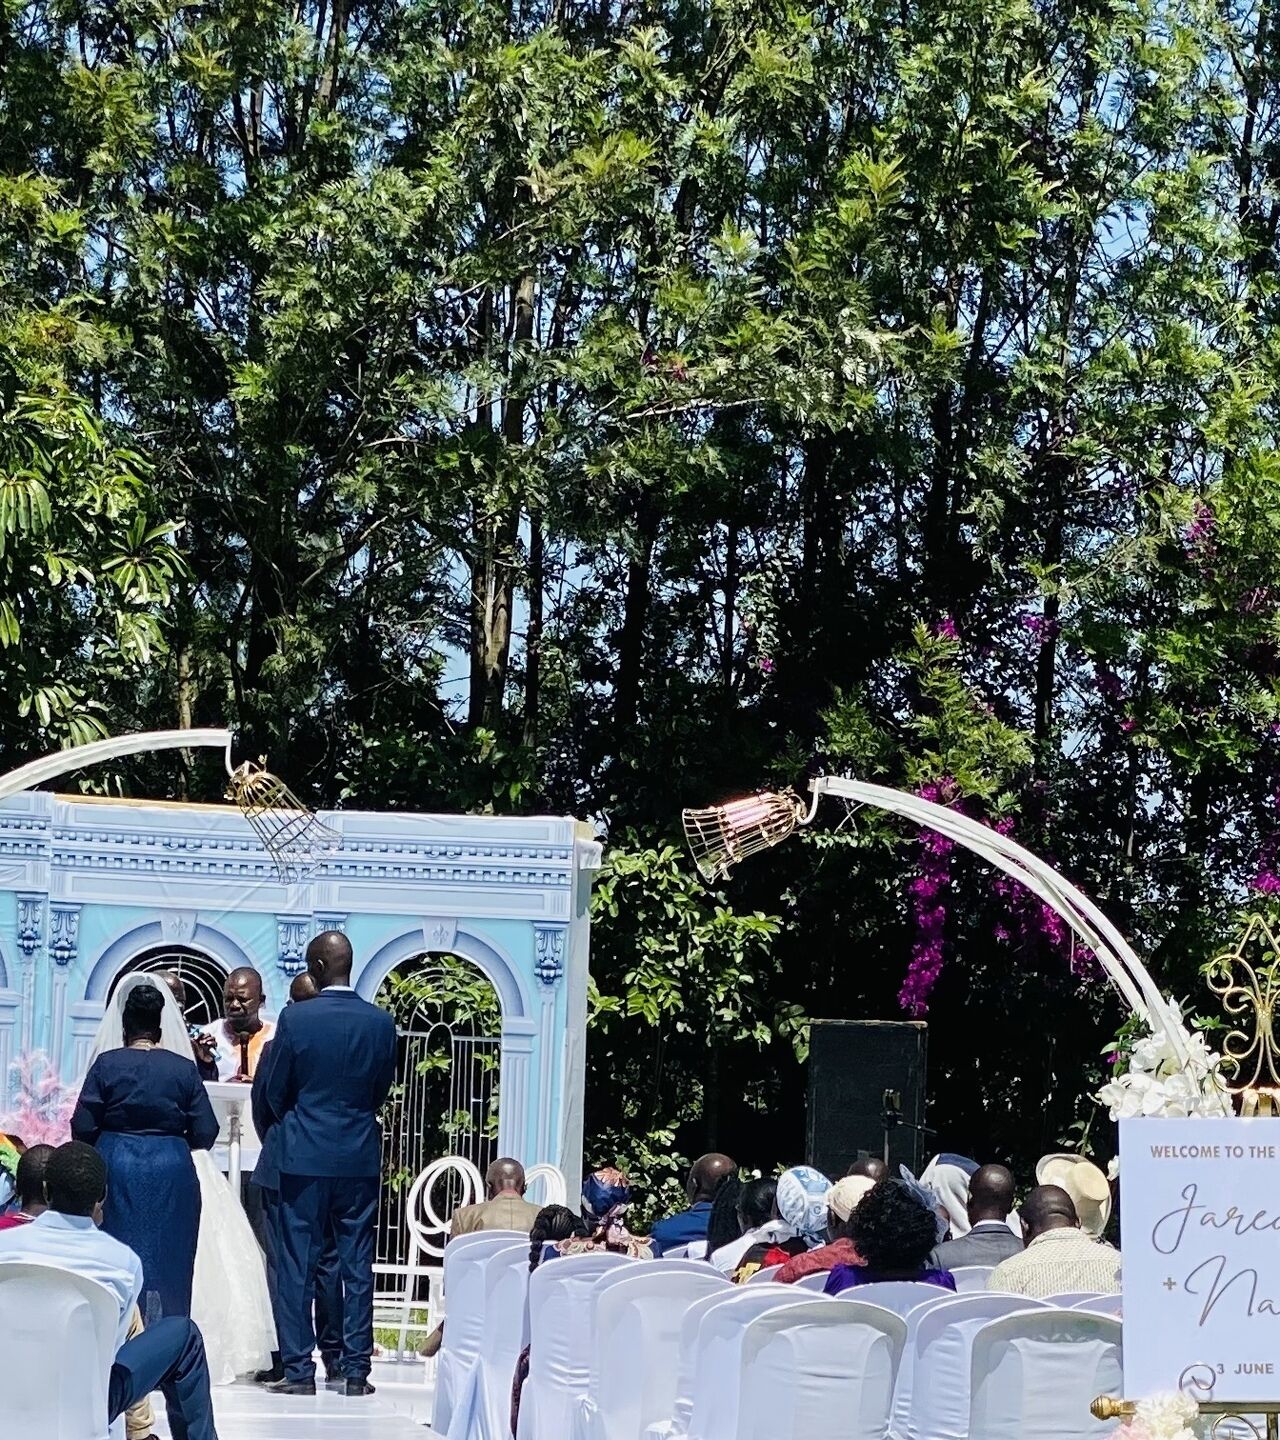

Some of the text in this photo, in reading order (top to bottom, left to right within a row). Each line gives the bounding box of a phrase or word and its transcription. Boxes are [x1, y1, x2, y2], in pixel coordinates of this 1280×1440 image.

[1150, 1145, 1220, 1158] WELCOME
[1225, 1145, 1244, 1158] TO
[1249, 1146, 1275, 1158] THE
[1234, 1363, 1274, 1375] JUNE
